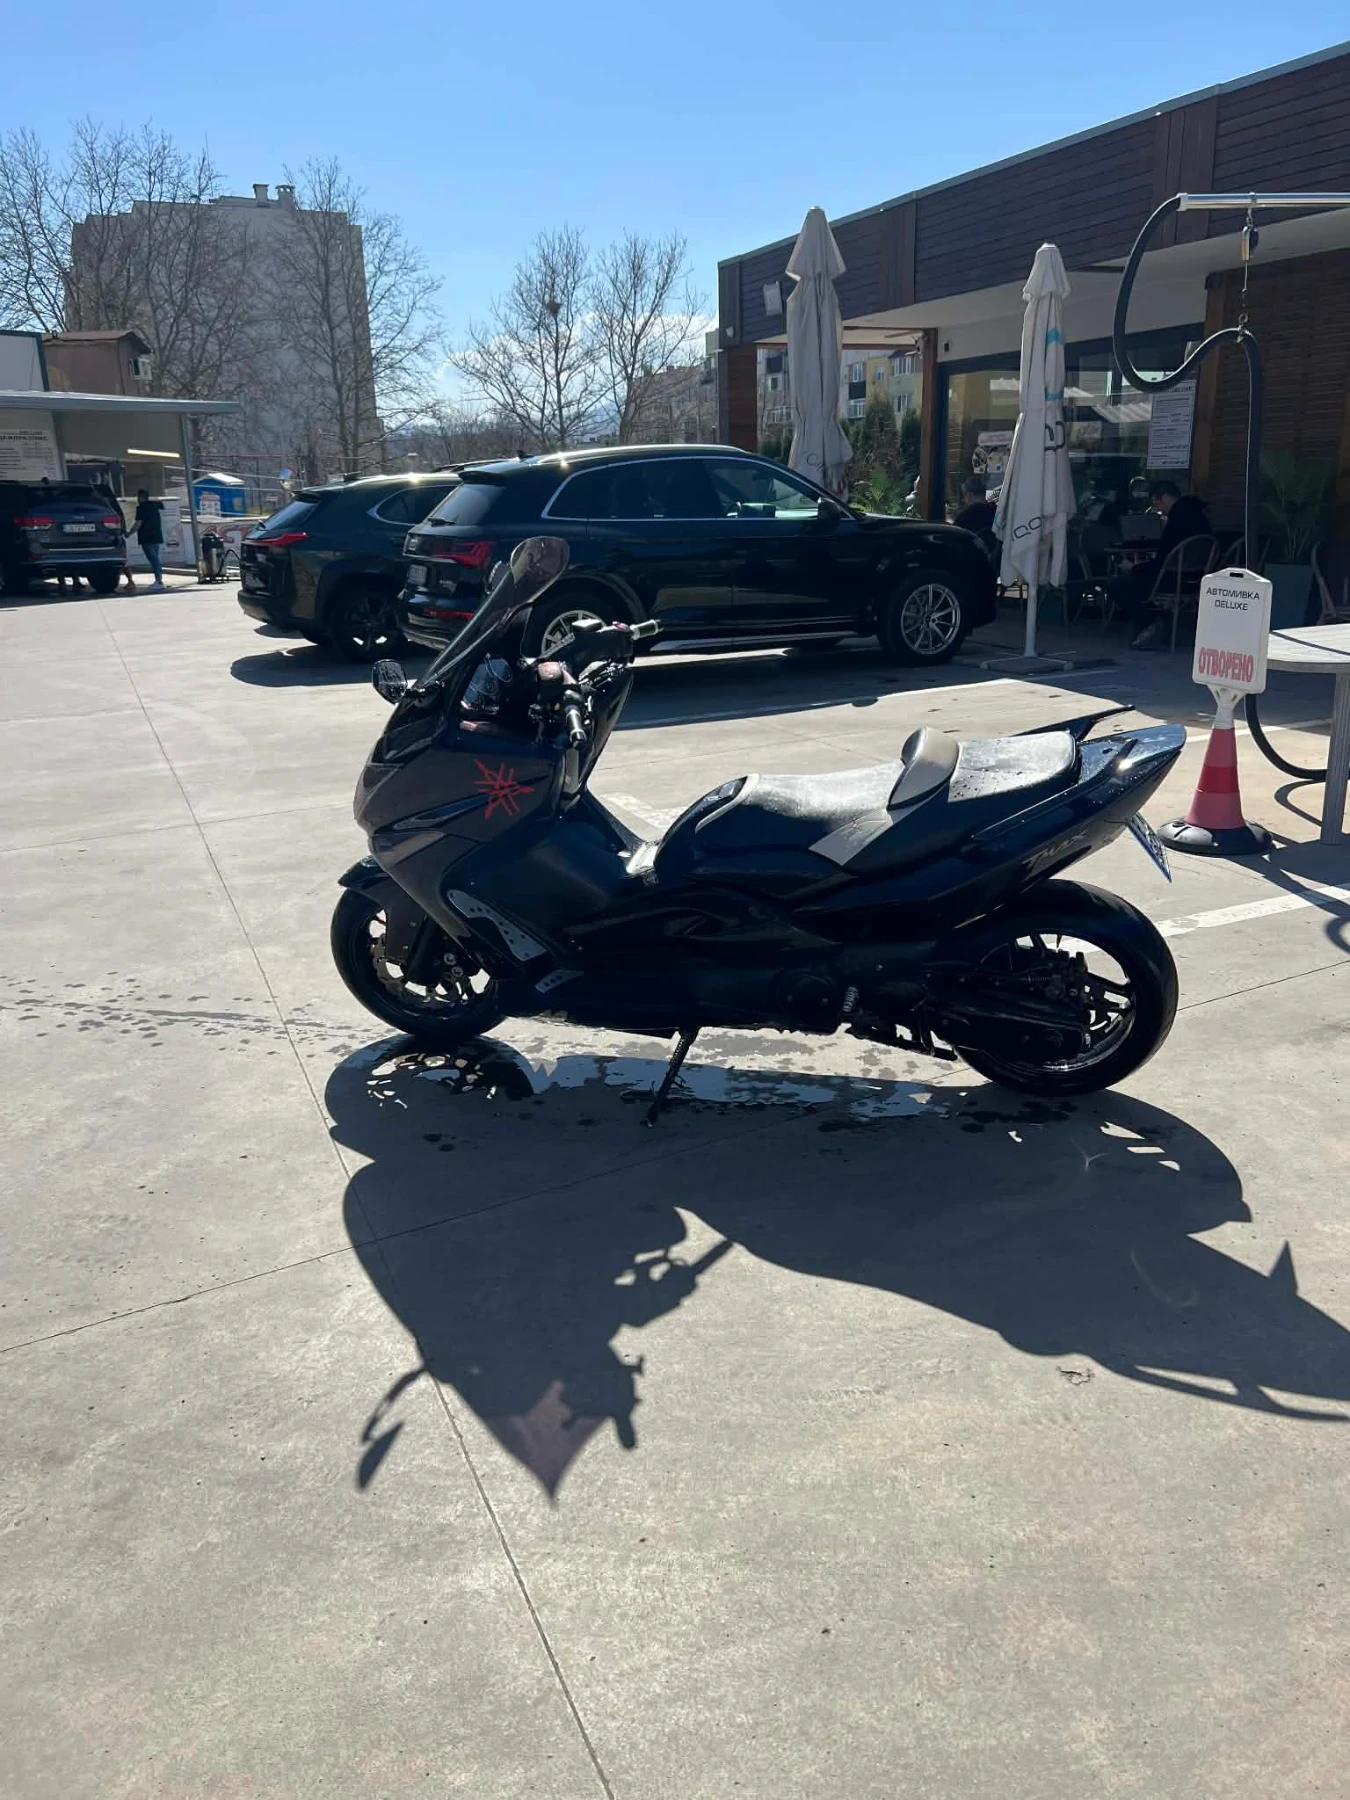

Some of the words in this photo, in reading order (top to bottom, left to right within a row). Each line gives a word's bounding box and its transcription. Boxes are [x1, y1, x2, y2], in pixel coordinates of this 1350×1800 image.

[1206, 587, 1260, 600] АВТОМИВКА
[1214, 600, 1249, 611] DELUXE
[1198, 647, 1254, 682] ОТВОРЕНО
